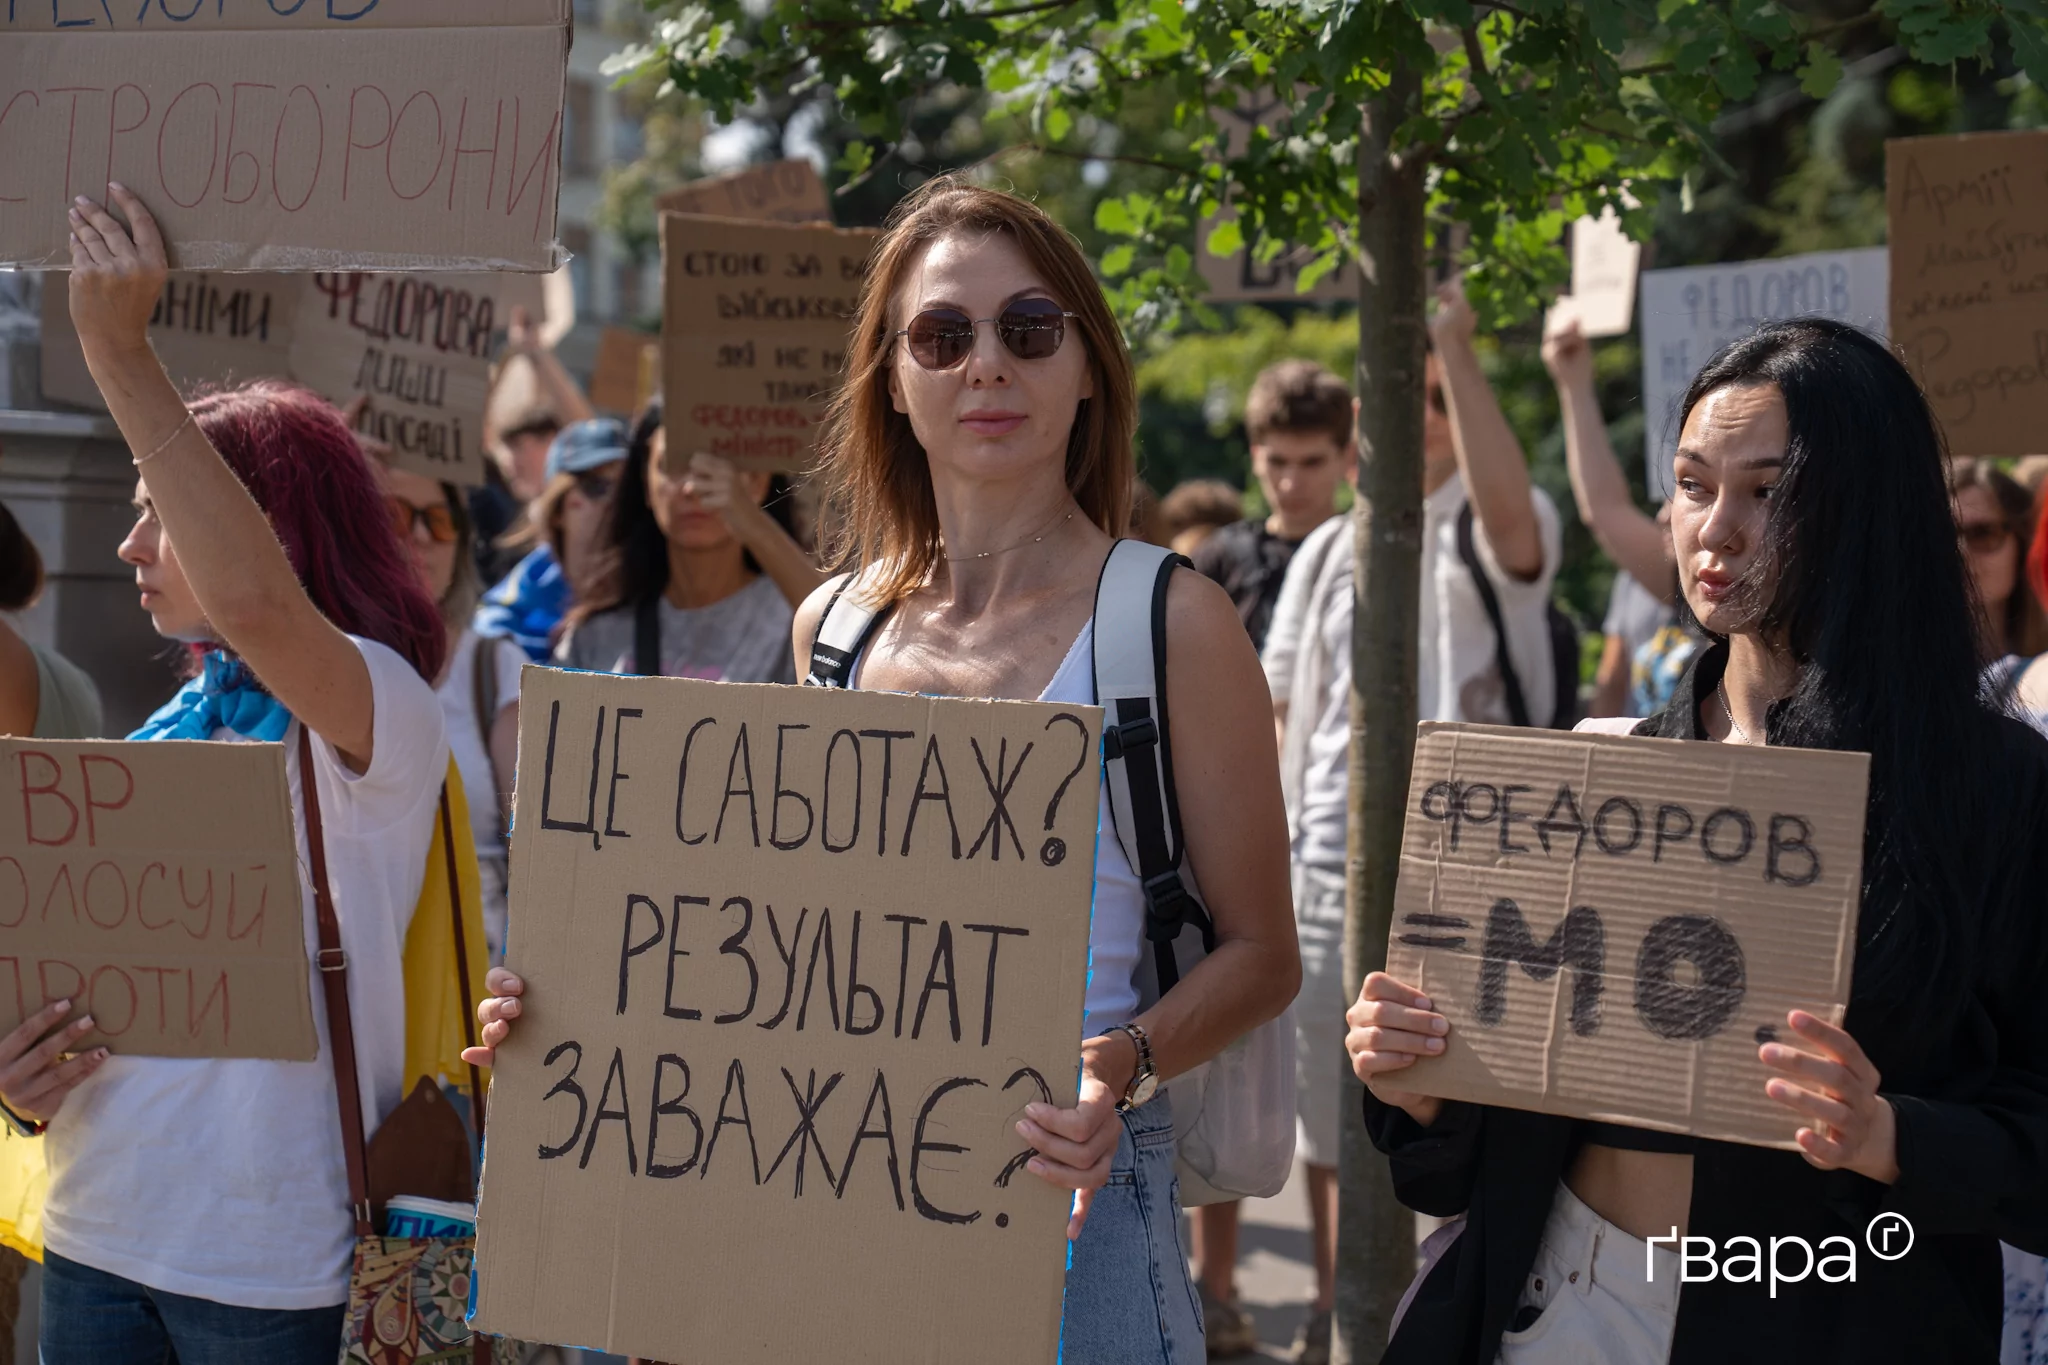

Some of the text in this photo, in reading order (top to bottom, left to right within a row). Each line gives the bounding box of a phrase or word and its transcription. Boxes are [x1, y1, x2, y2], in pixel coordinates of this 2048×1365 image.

[18, 750, 135, 847] ВР
[541, 699, 1090, 867] ЦЕ САБОТАЖ?
[1419, 780, 1823, 888] ФЕДОРОВ
[615, 893, 1030, 1047] РЕЗУЛЬТАТ
[537, 1040, 1054, 1229] ЗАВАЖАЄ?
